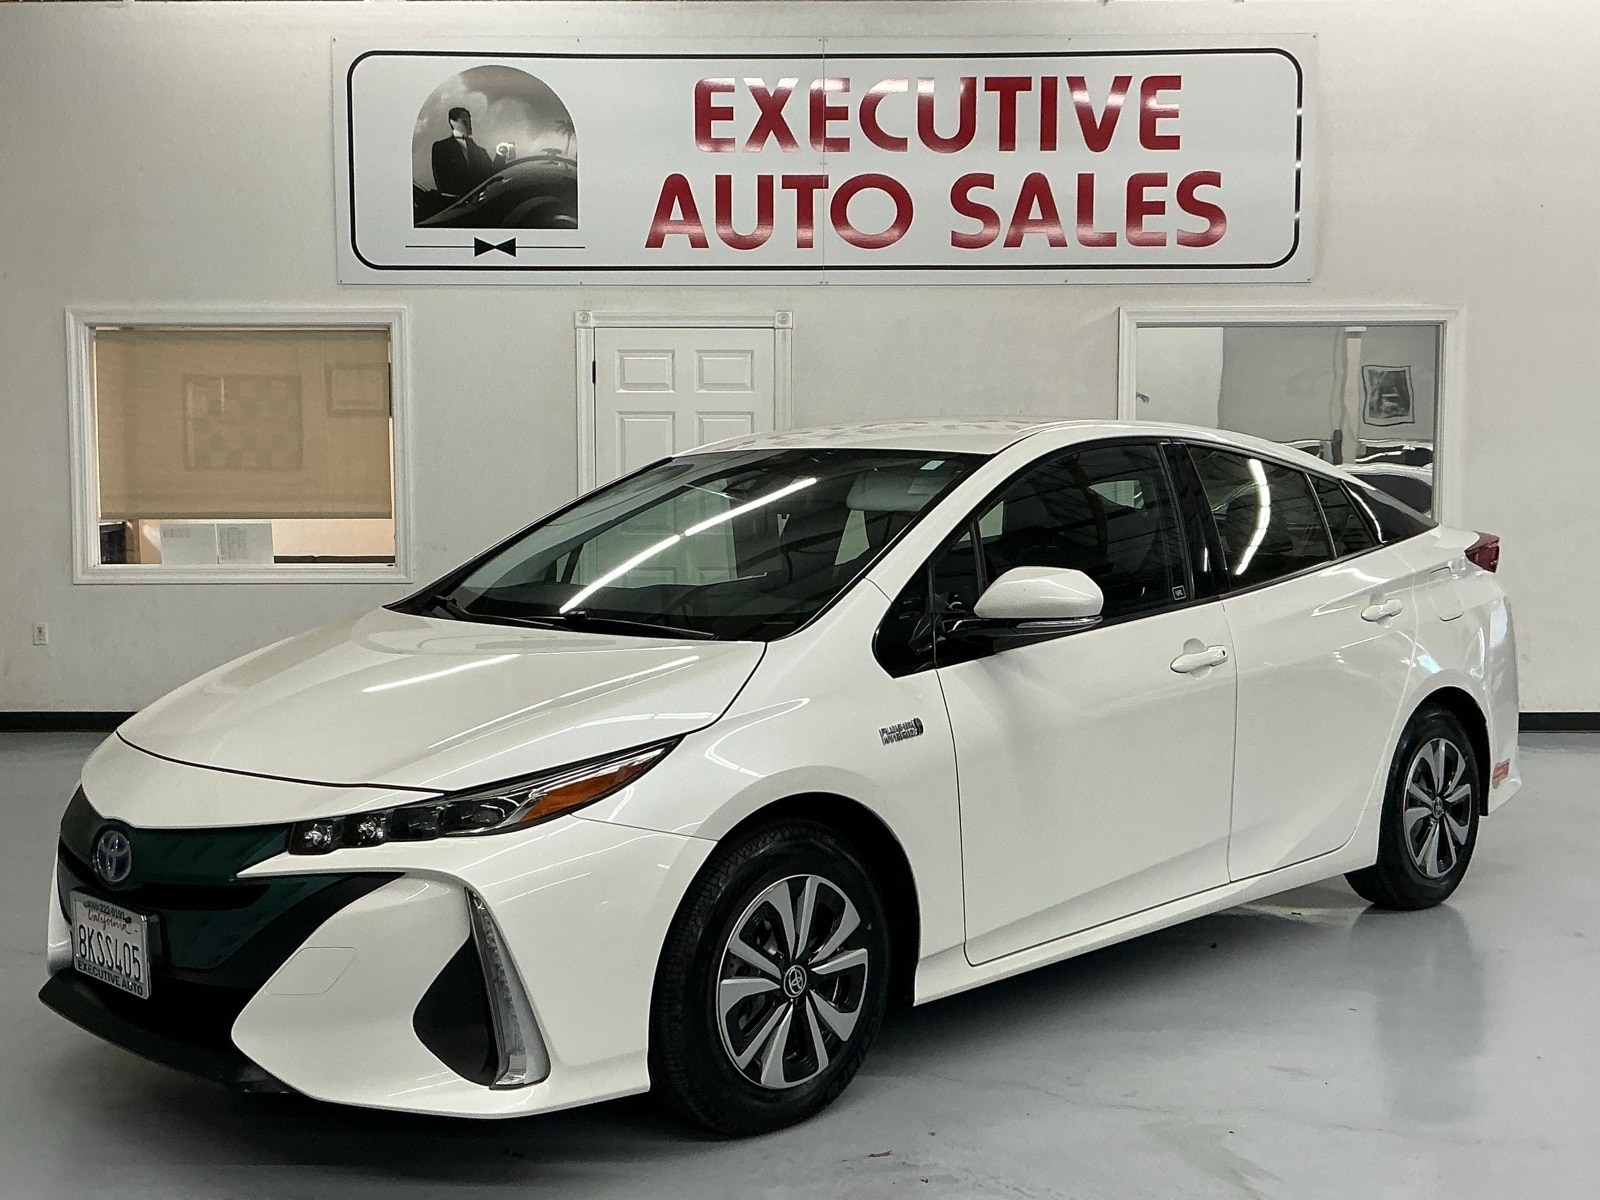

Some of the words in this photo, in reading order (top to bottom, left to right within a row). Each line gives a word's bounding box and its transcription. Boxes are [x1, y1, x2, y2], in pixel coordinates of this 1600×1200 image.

[694, 75, 1182, 154] EXECUTIVE
[645, 173, 914, 250] AUTO
[950, 171, 1227, 250] SALES
[88, 910, 131, 934] California
[78, 924, 142, 982] 8KSS405
[78, 960, 120, 987] EXECUTIVE
[122, 979, 144, 996] AUTO
